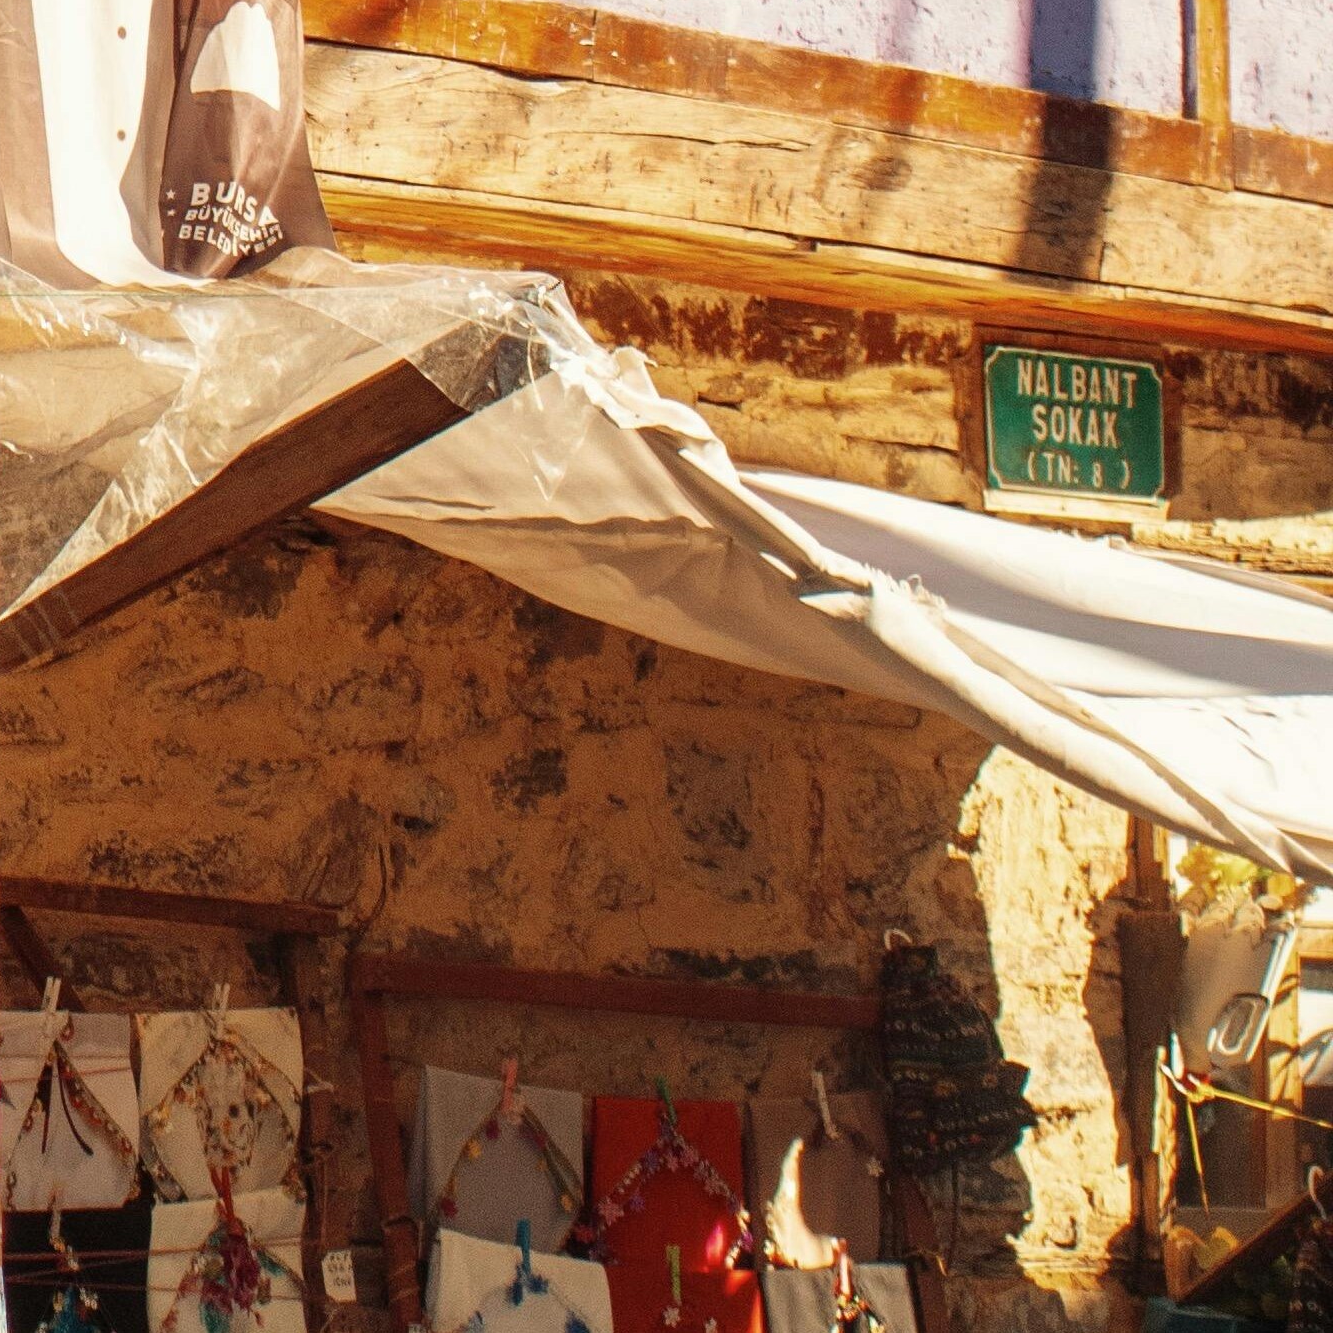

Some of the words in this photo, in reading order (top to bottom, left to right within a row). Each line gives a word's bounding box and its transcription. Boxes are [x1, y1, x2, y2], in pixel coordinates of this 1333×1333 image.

[191, 182, 279, 226] BURSA
[1018, 359, 1137, 408] NALBANT
[1032, 403, 1118, 448] SOKAK
